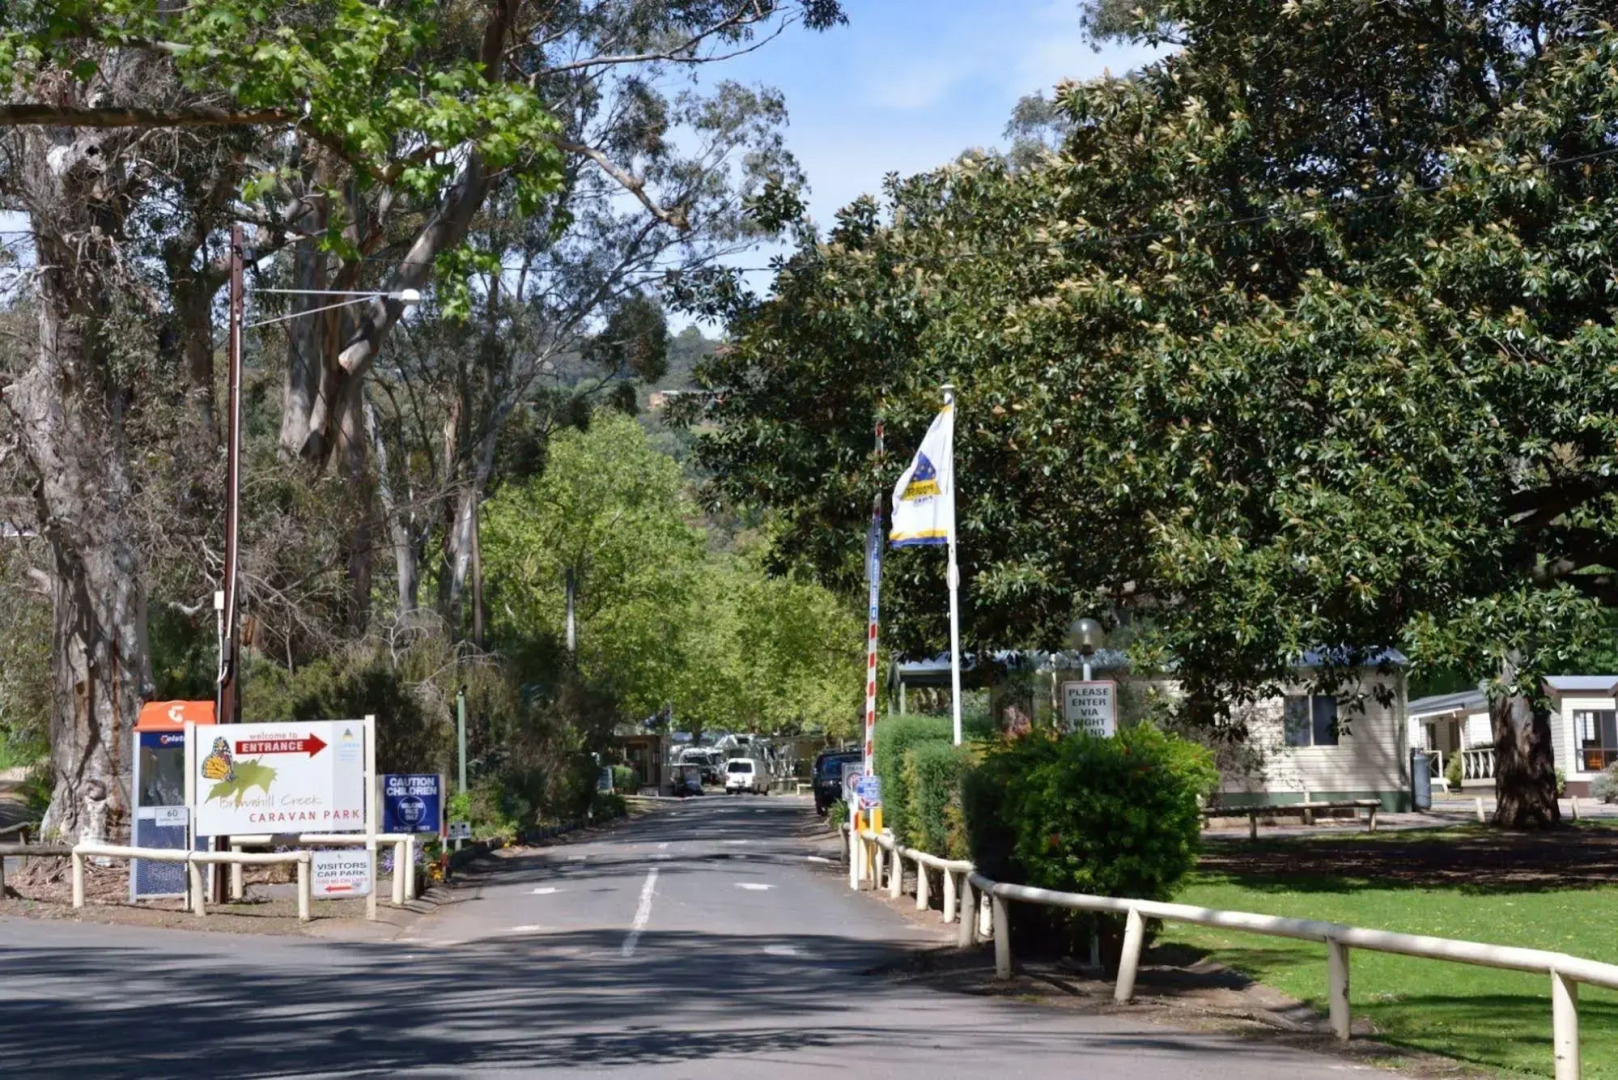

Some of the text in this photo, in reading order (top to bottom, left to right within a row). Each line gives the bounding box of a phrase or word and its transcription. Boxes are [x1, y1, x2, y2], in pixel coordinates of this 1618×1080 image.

[1068, 688, 1109, 696] PLEASE
[1081, 708, 1099, 716] VIA
[250, 731, 298, 740] welcome to
[242, 741, 304, 753] ENTRANCE
[389, 777, 435, 787] CAUTION
[386, 786, 438, 796] CHILDREN
[281, 795, 322, 806] Creek
[167, 809, 179, 818] 60
[250, 809, 360, 822] CARAVAN PARK
[317, 862, 367, 870] VISITORS
